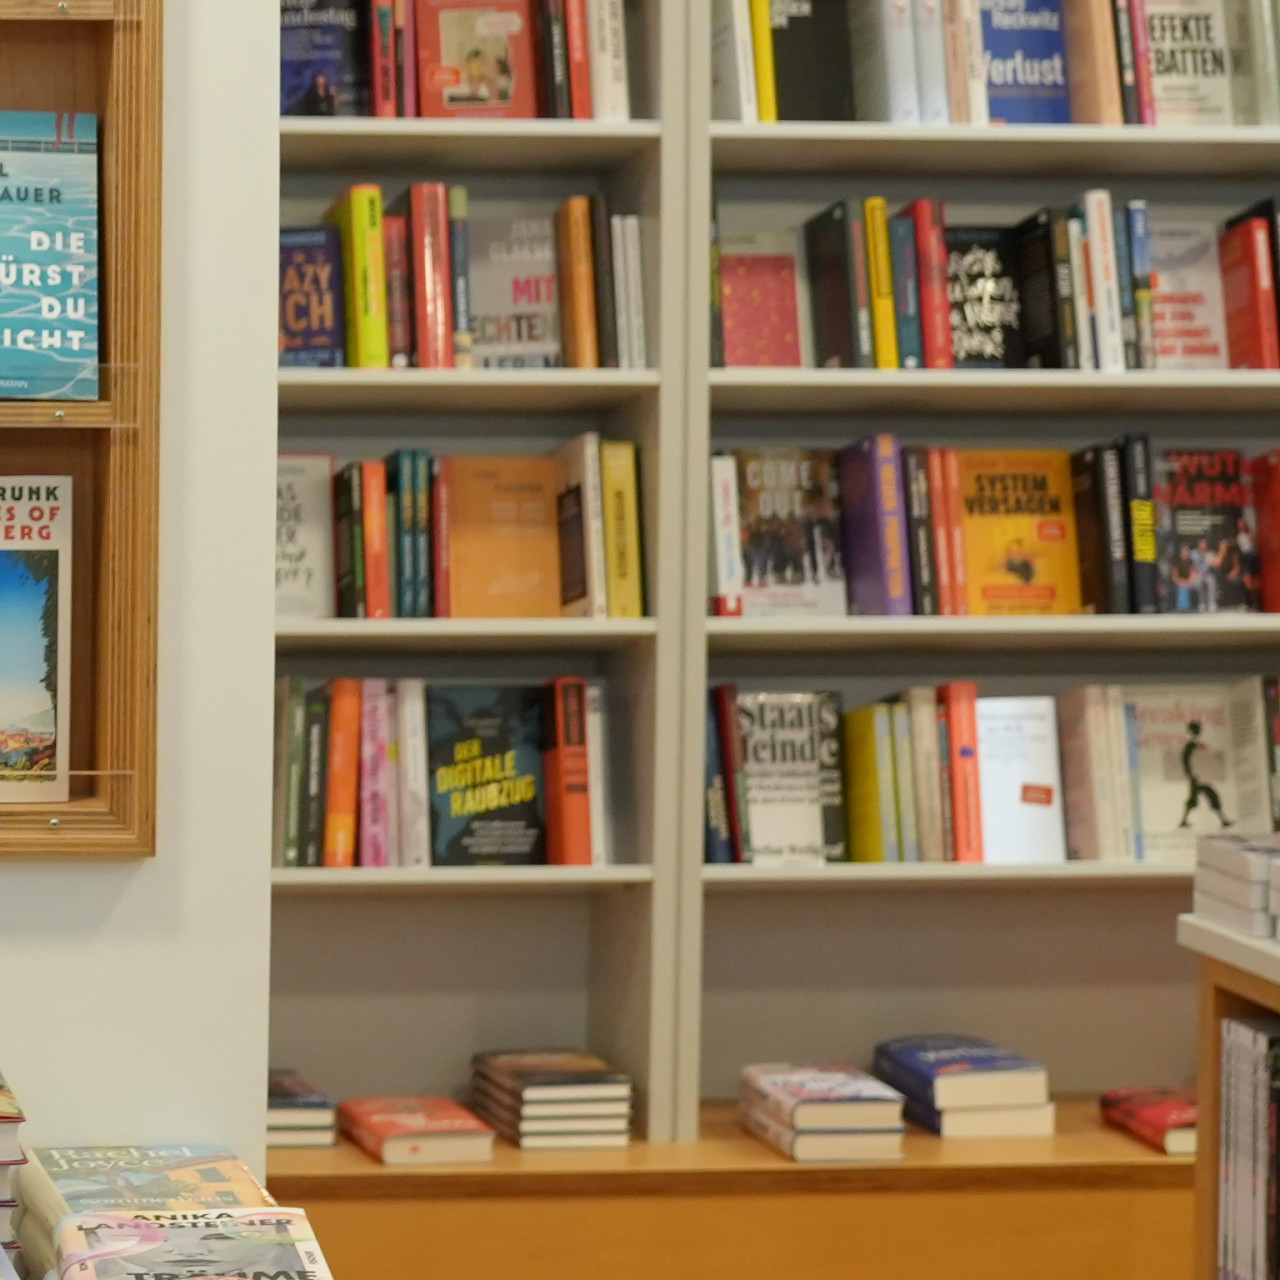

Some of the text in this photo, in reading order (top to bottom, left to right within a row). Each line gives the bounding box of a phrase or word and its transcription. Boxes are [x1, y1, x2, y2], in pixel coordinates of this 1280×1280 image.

[1149, 13, 1214, 42] EFEKTE
[1150, 47, 1226, 76] EBATTEN
[30, 231, 85, 255] DIE
[283, 263, 332, 291] AZY
[512, 276, 555, 305] MIT
[41, 296, 86, 319] DU
[285, 293, 334, 332] CH
[974, 473, 1050, 494] SYSTEM
[28, 505, 61, 522] OF
[963, 494, 1062, 516] VERSAGEN
[435, 749, 517, 794] DIGITALE
[449, 774, 536, 818] RAUBZUG
[47, 1146, 193, 1160] Rachel
[51, 1158, 170, 1171] Joyce
[76, 1218, 294, 1233] LANDSTEINER
[131, 1211, 236, 1222] ANIKA
